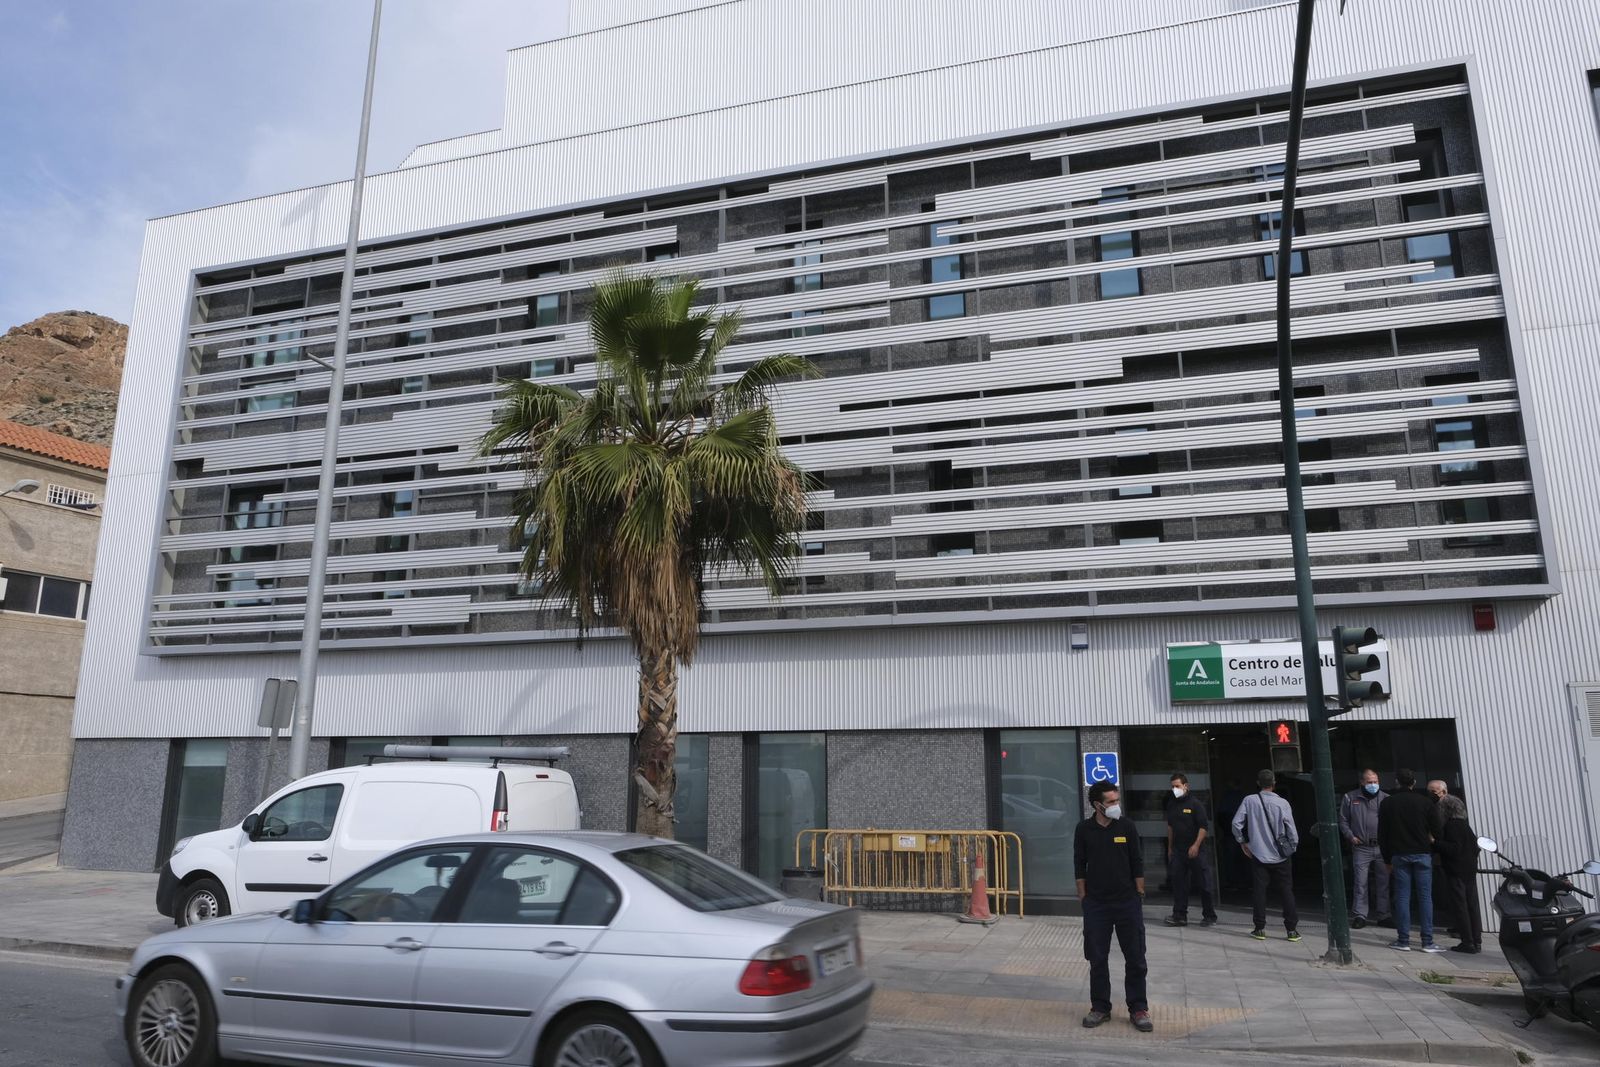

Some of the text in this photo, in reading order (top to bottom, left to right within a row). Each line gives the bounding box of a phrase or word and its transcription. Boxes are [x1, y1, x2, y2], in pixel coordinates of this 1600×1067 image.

[1228, 658, 1279, 670] Centro
[1283, 656, 1302, 668] de
[1229, 675, 1303, 687] Casa del Mar
